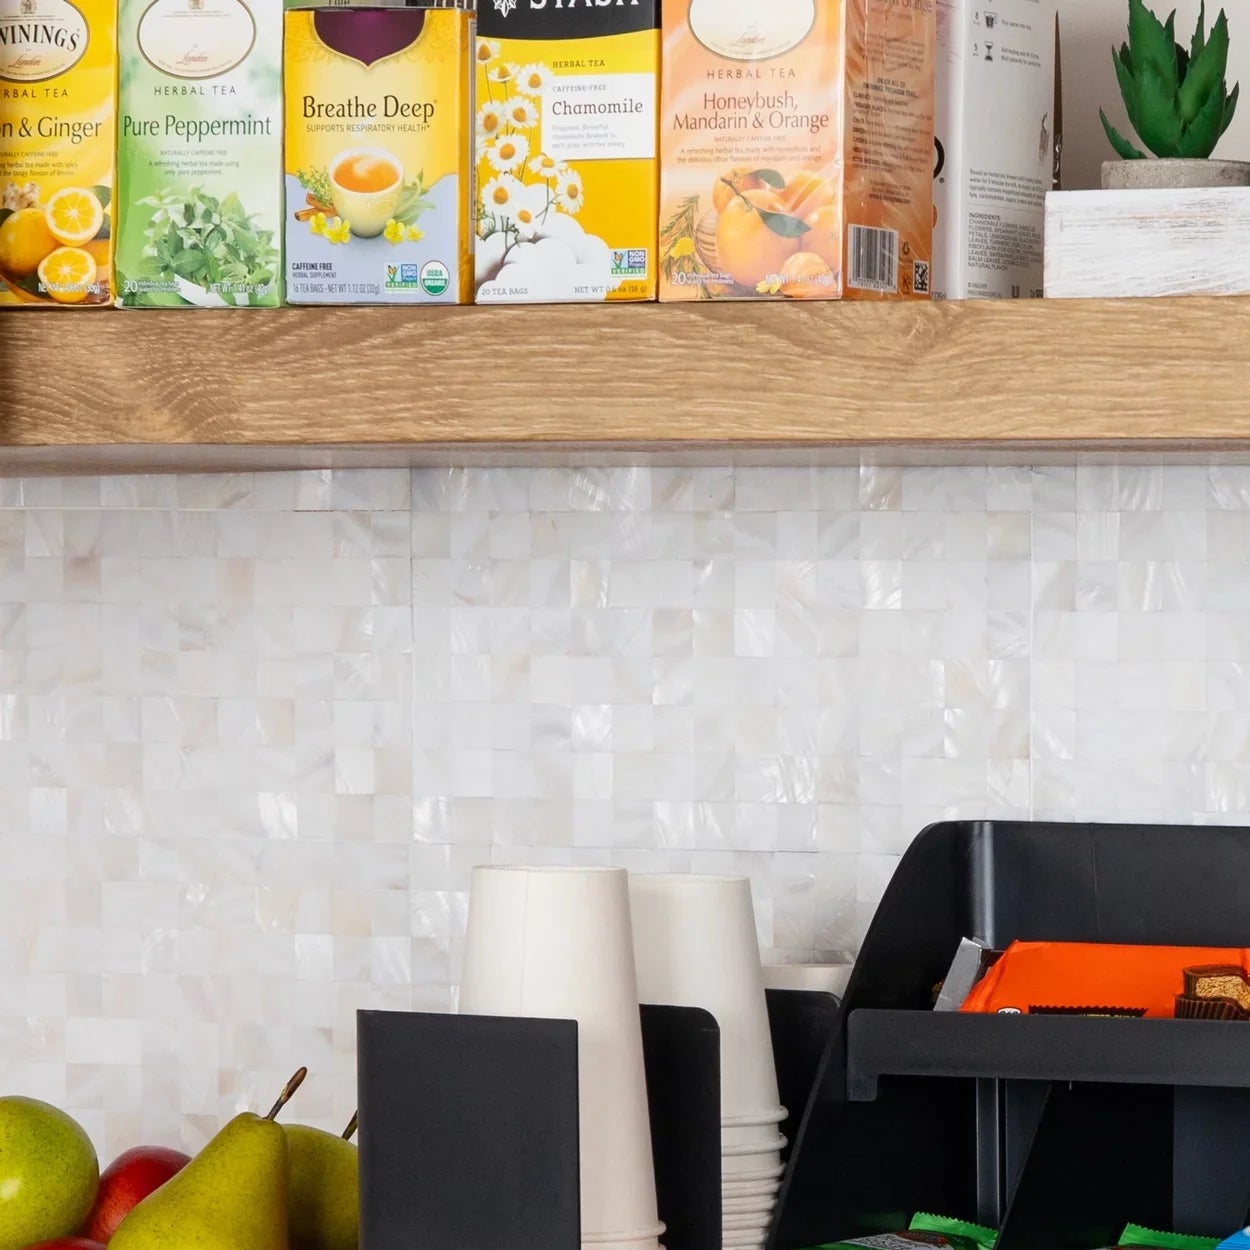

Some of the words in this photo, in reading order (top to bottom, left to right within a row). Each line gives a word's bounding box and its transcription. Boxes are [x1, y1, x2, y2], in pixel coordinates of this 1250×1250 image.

[707, 69, 762, 79] HERBAL
[771, 68, 796, 78] TEA
[44, 89, 69, 98] TEA
[154, 86, 205, 95] HERBAL
[213, 86, 237, 95] TEA
[303, 95, 377, 118] Breathe
[552, 98, 644, 116] Chamomile
[703, 90, 799, 114] Honeybush,
[123, 115, 160, 137] Pure
[165, 114, 272, 143] Peppermint
[306, 124, 345, 132] SUPPORTS
[346, 124, 395, 132] RESPIRATORY
[673, 112, 748, 130] Mandarin
[752, 112, 764, 129] &
[769, 111, 830, 134] Orange
[18, 117, 33, 138] &
[37, 116, 102, 145] Ginger
[671, 272, 687, 285] 20
[124, 280, 138, 292] 20
[574, 286, 589, 294] NET
[591, 286, 604, 294] WT
